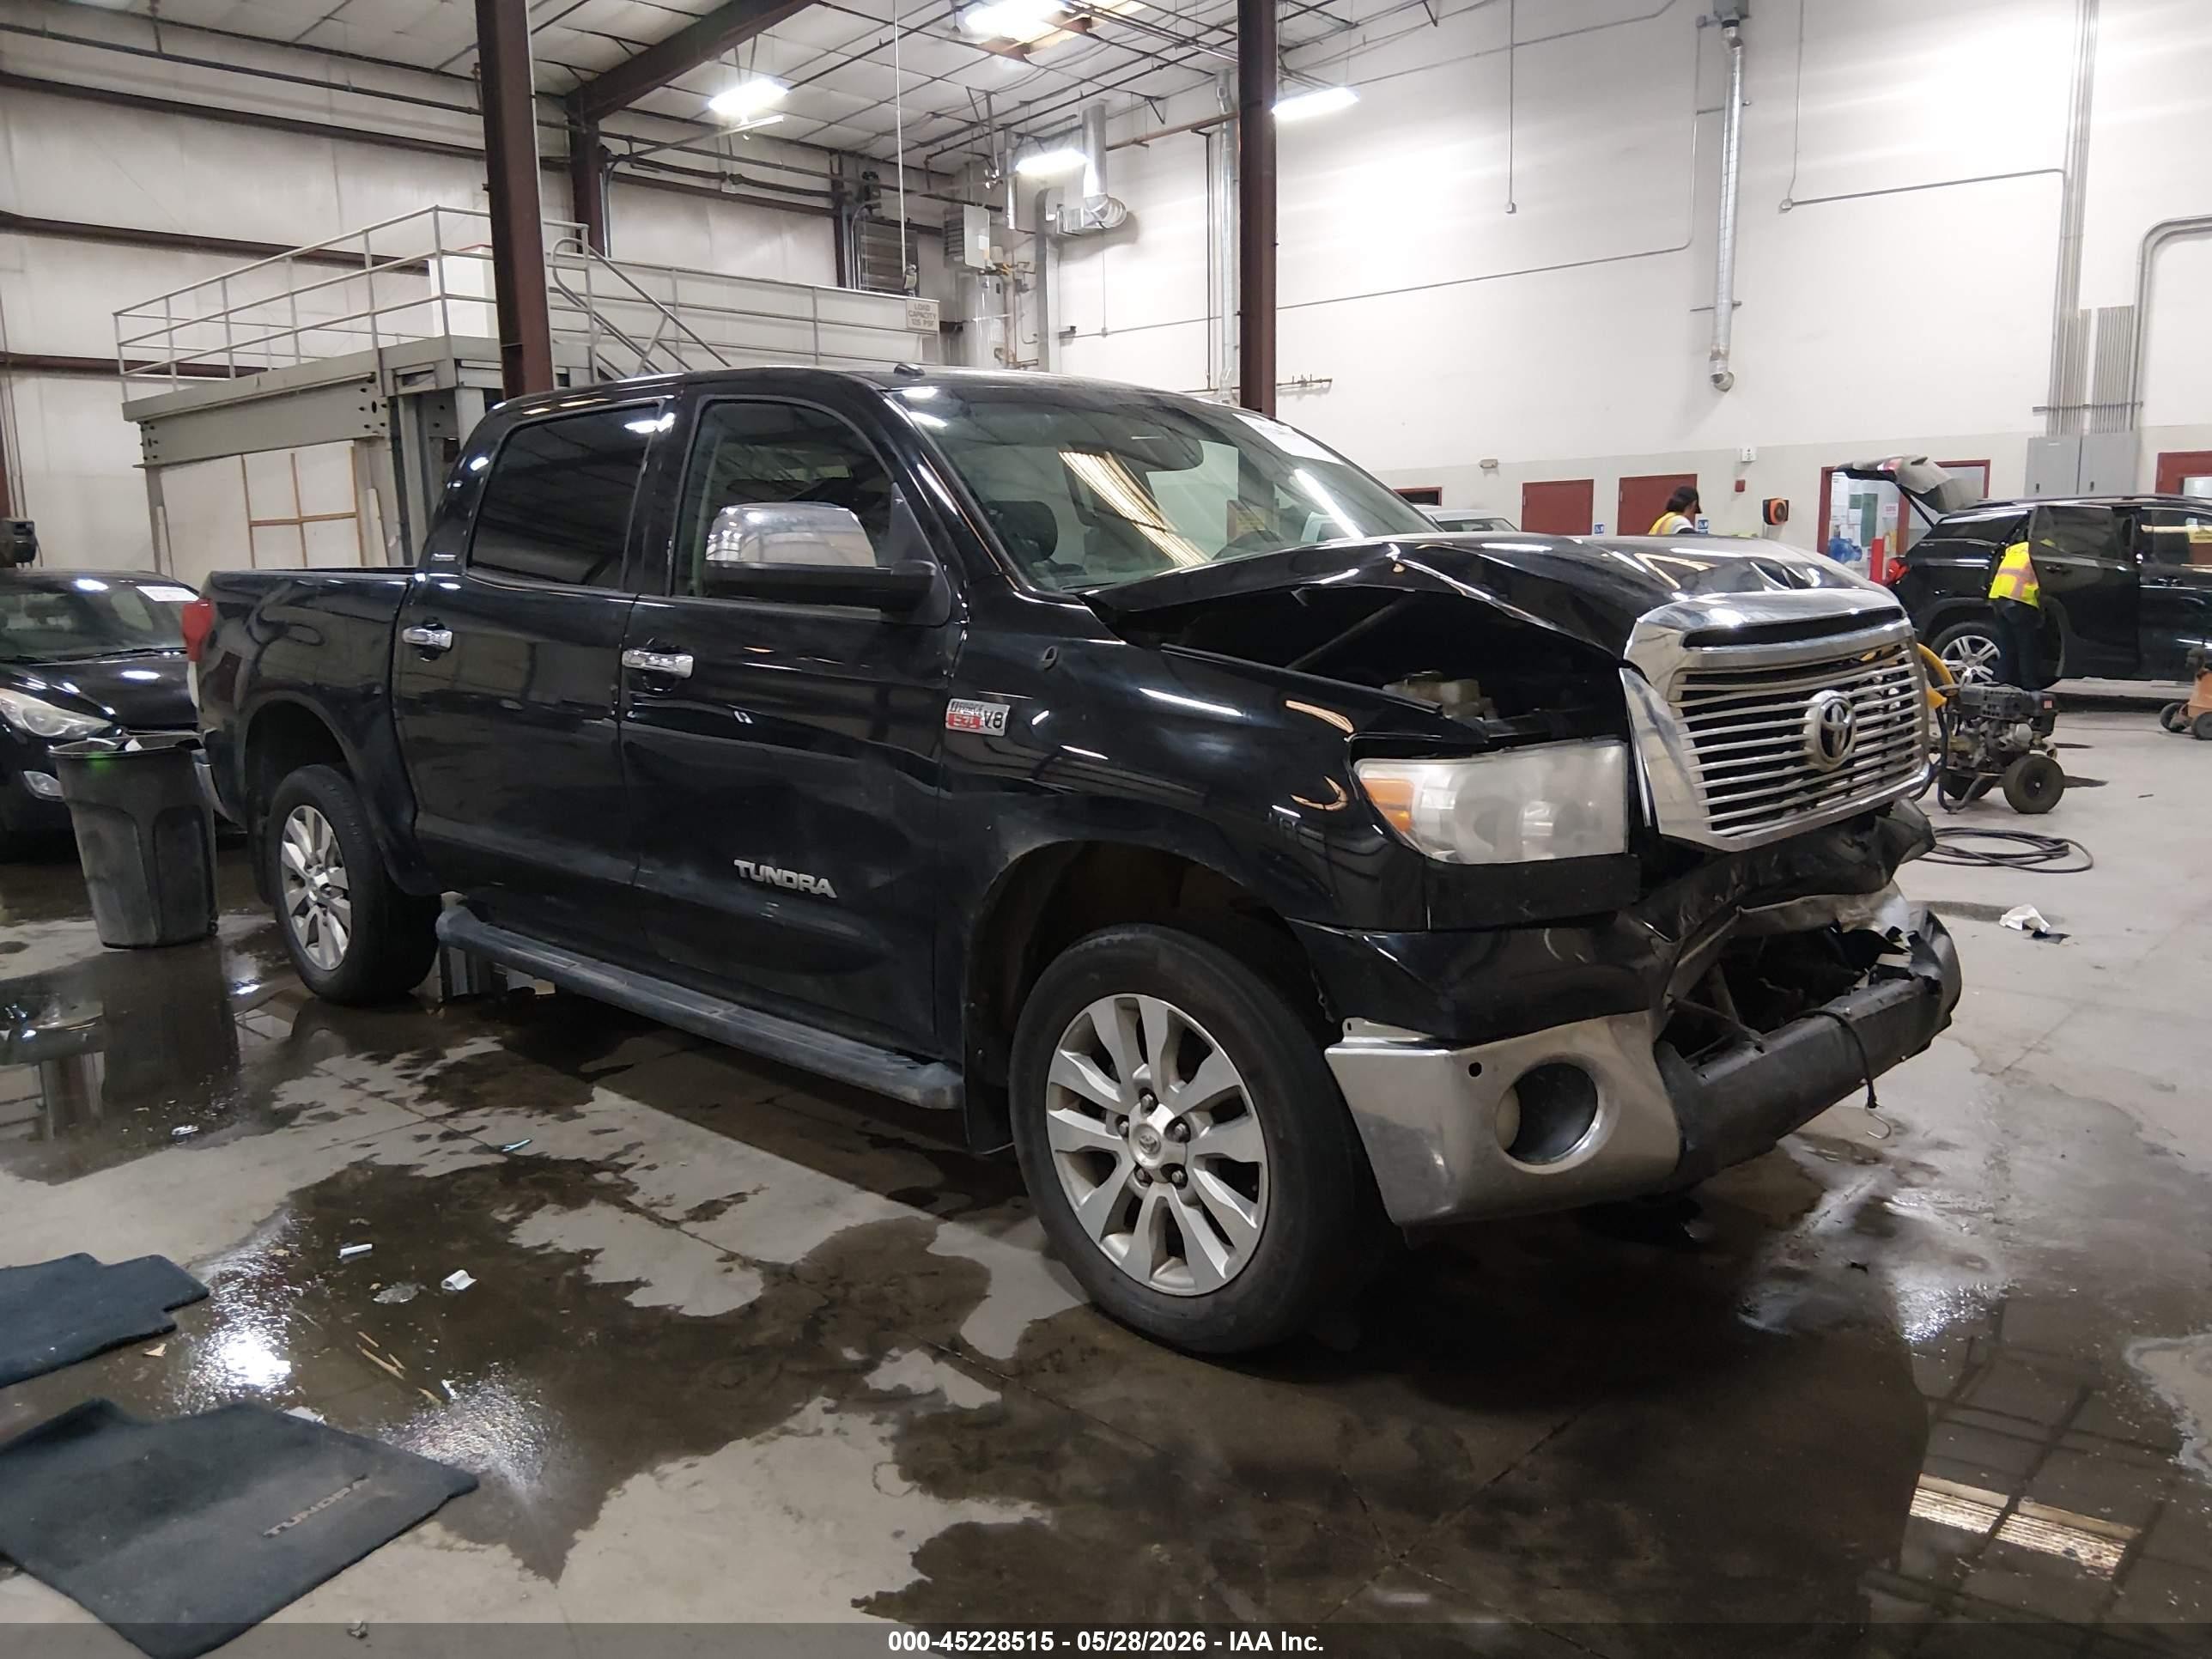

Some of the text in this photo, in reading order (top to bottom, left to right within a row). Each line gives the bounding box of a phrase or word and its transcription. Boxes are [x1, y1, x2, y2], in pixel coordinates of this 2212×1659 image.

[984, 709, 1004, 729] V8
[733, 859, 838, 899] TUNDRA
[262, 1475, 370, 1538] TUNDRA
